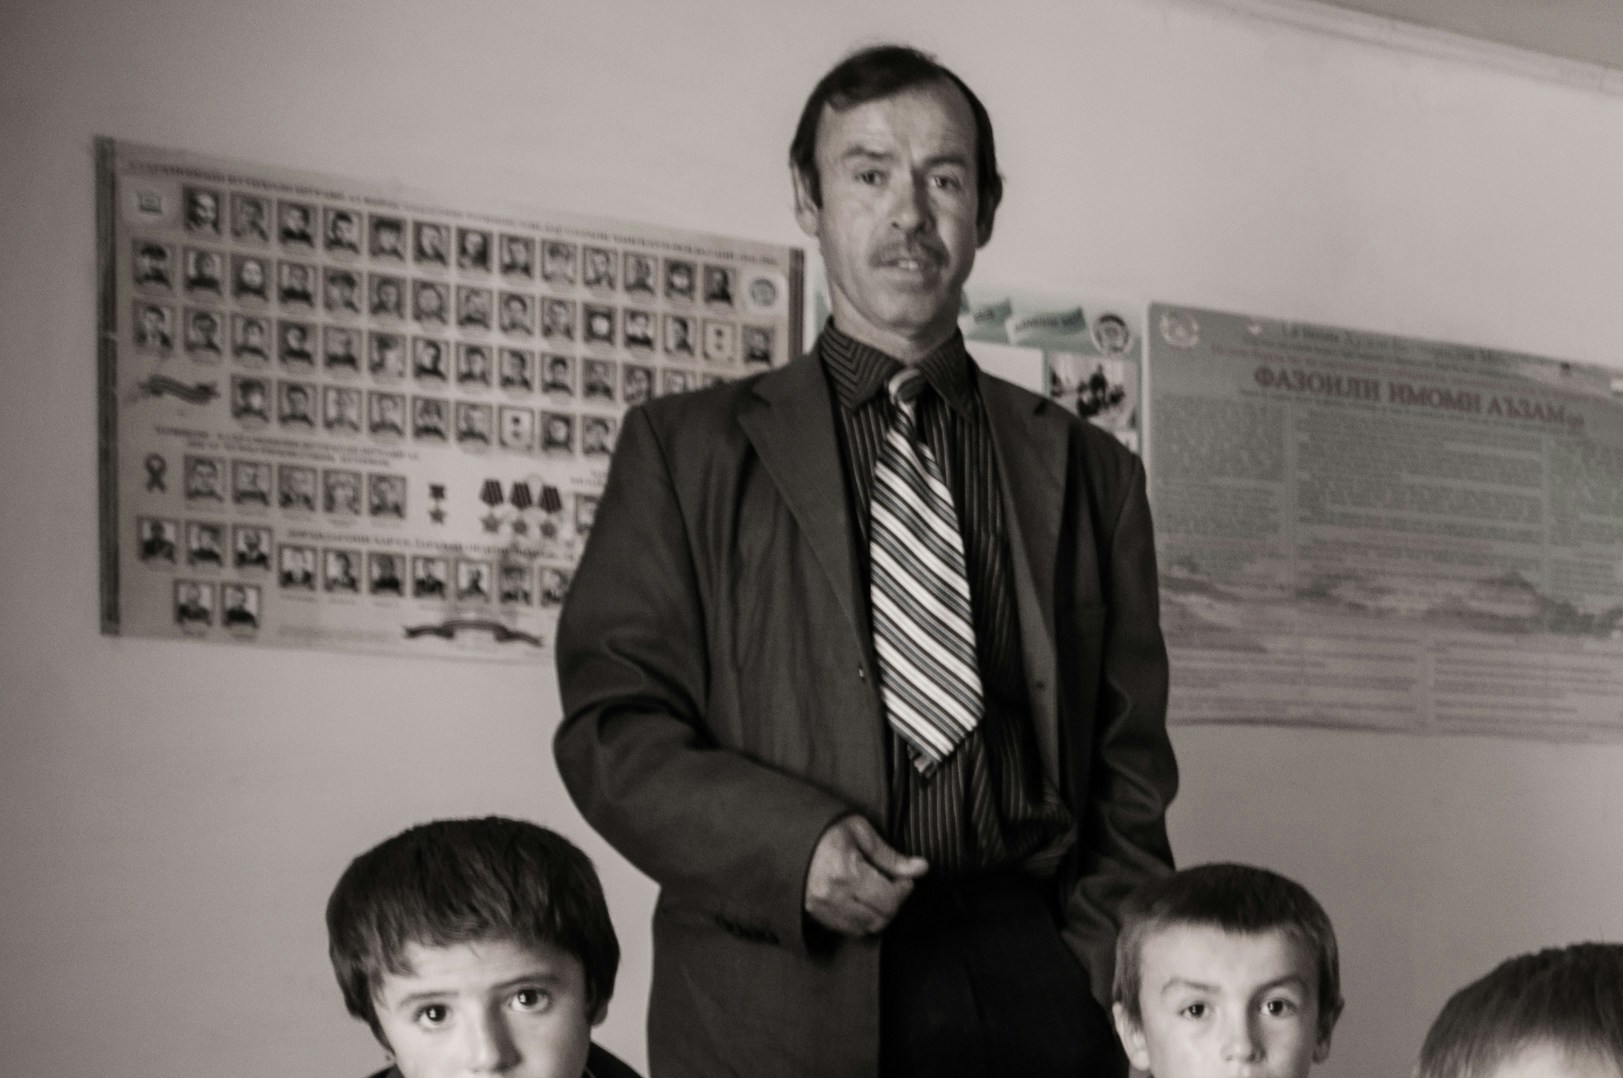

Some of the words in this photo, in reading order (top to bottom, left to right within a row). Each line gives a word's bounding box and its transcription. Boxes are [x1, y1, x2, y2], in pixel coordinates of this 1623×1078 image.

[1253, 365, 1381, 403] ФАЗОИЛИ
[1388, 379, 1482, 415] ИМОМИ
[1487, 394, 1566, 424] АЪЗАМ
